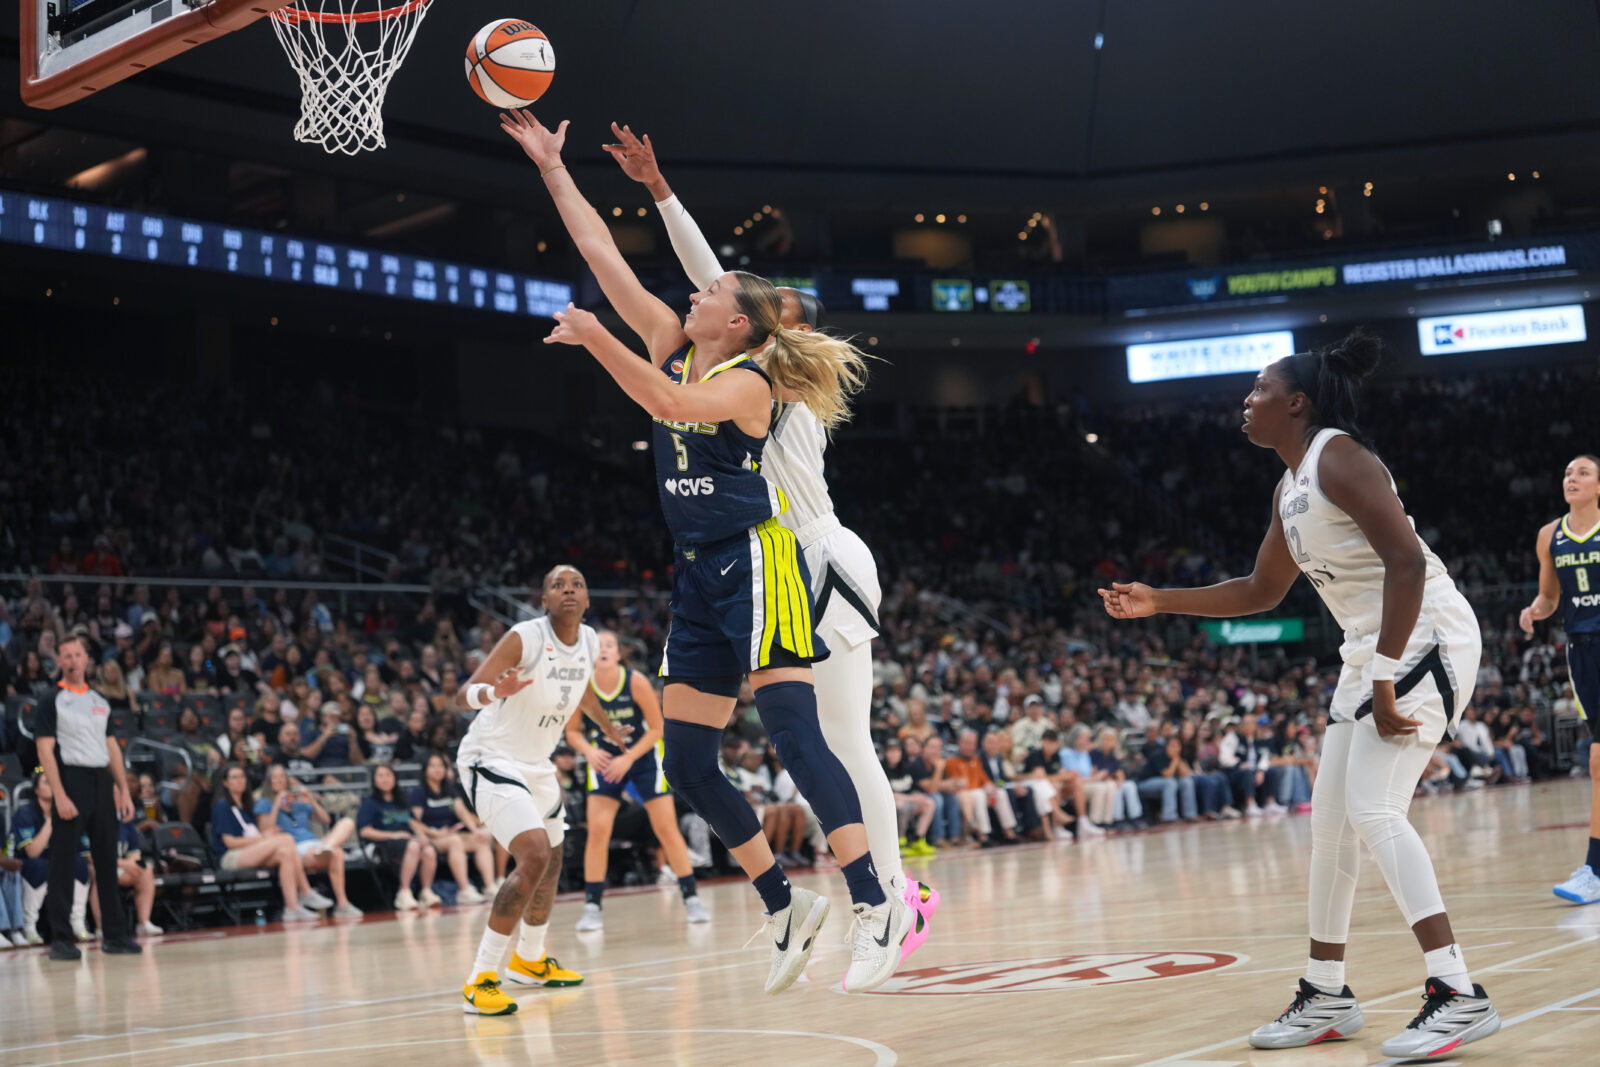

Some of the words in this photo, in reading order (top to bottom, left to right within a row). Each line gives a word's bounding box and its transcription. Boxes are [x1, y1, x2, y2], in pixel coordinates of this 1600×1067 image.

[1227, 272, 1280, 295] YOUTH
[1280, 266, 1336, 290] CAMPS
[1342, 259, 1416, 284] REGISTER
[1415, 245, 1565, 277] DALLASWINGS.COM
[669, 432, 688, 472] 5
[678, 476, 714, 496] CVS
[1284, 526, 1311, 564] 12
[1575, 567, 1590, 592] 8
[1580, 594, 1600, 607] CV
[546, 666, 585, 681] ACES
[556, 685, 572, 711] 3
